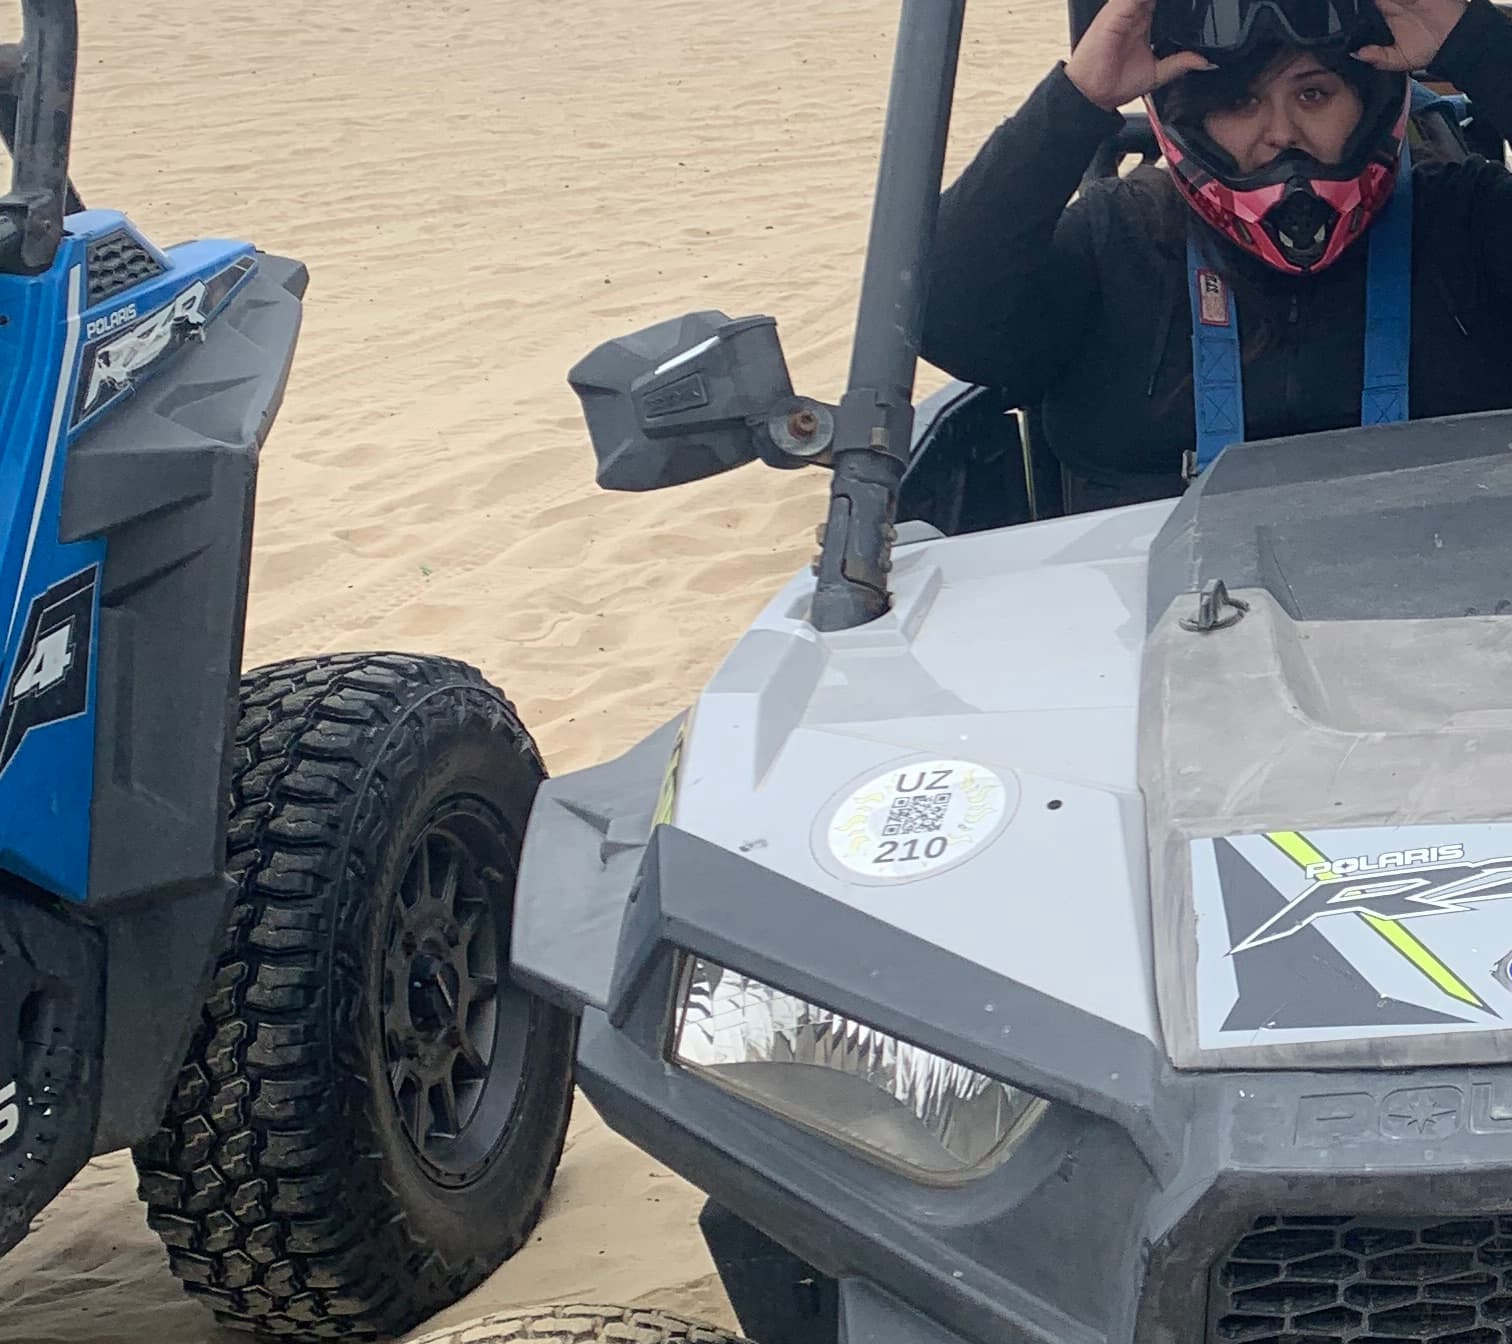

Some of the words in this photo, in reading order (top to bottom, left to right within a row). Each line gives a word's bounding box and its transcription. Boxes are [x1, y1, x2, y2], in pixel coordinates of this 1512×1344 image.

[86, 303, 137, 339] POLARIS
[12, 623, 72, 698] 4
[895, 769, 953, 793] UZ
[871, 836, 949, 864] 210
[1305, 843, 1465, 880] POLARIS
